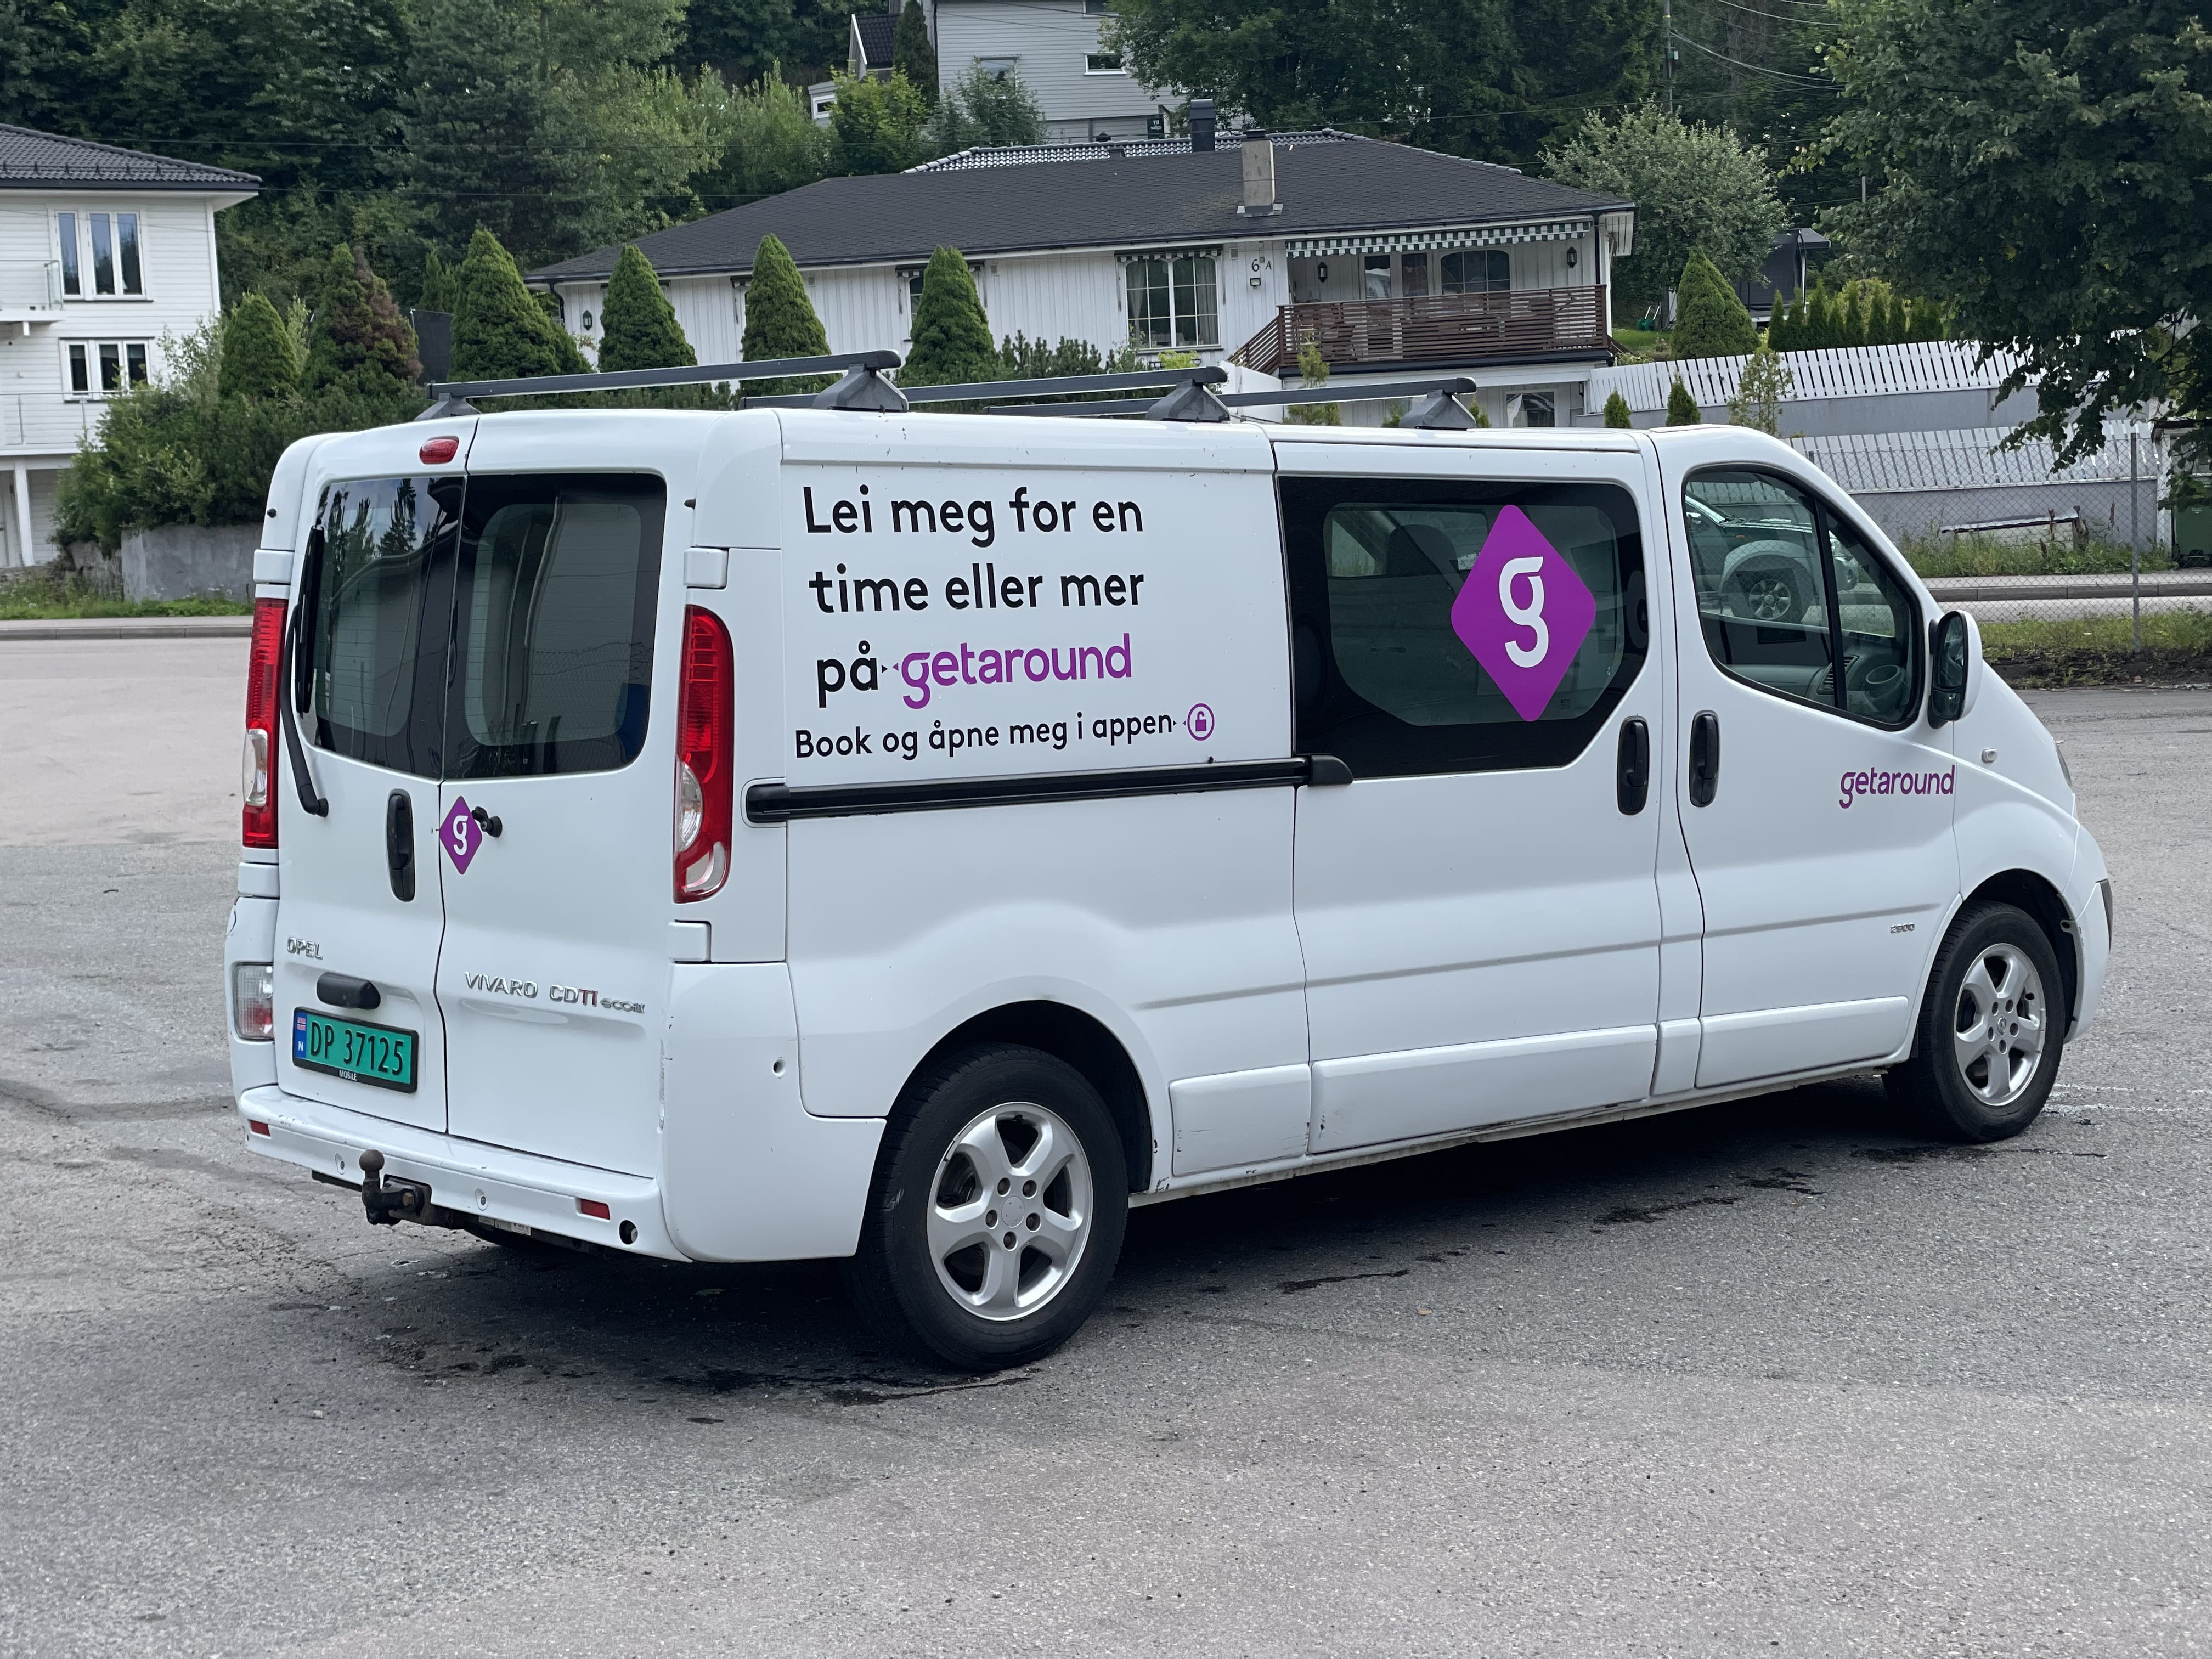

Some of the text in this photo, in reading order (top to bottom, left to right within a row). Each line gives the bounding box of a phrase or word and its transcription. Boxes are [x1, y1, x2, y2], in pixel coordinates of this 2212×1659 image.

[1251, 259, 1272, 272] 6 A
[803, 484, 1143, 548] Lei meg for en
[809, 562, 1144, 613] time eller mer
[1499, 556, 1549, 668] g
[816, 633, 1132, 709] på getaround
[795, 712, 1172, 761] Book og åpne meg i appen
[1839, 764, 1955, 809] getaround
[453, 815, 469, 856] g
[286, 936, 323, 961] OPEL
[1890, 922, 1915, 933] 2900
[465, 972, 539, 998] VIVARO
[549, 984, 599, 1007] CDTI
[298, 1041, 304, 1052] N
[311, 1021, 404, 1076] DP 37125
[339, 1069, 357, 1081] MOBILE
